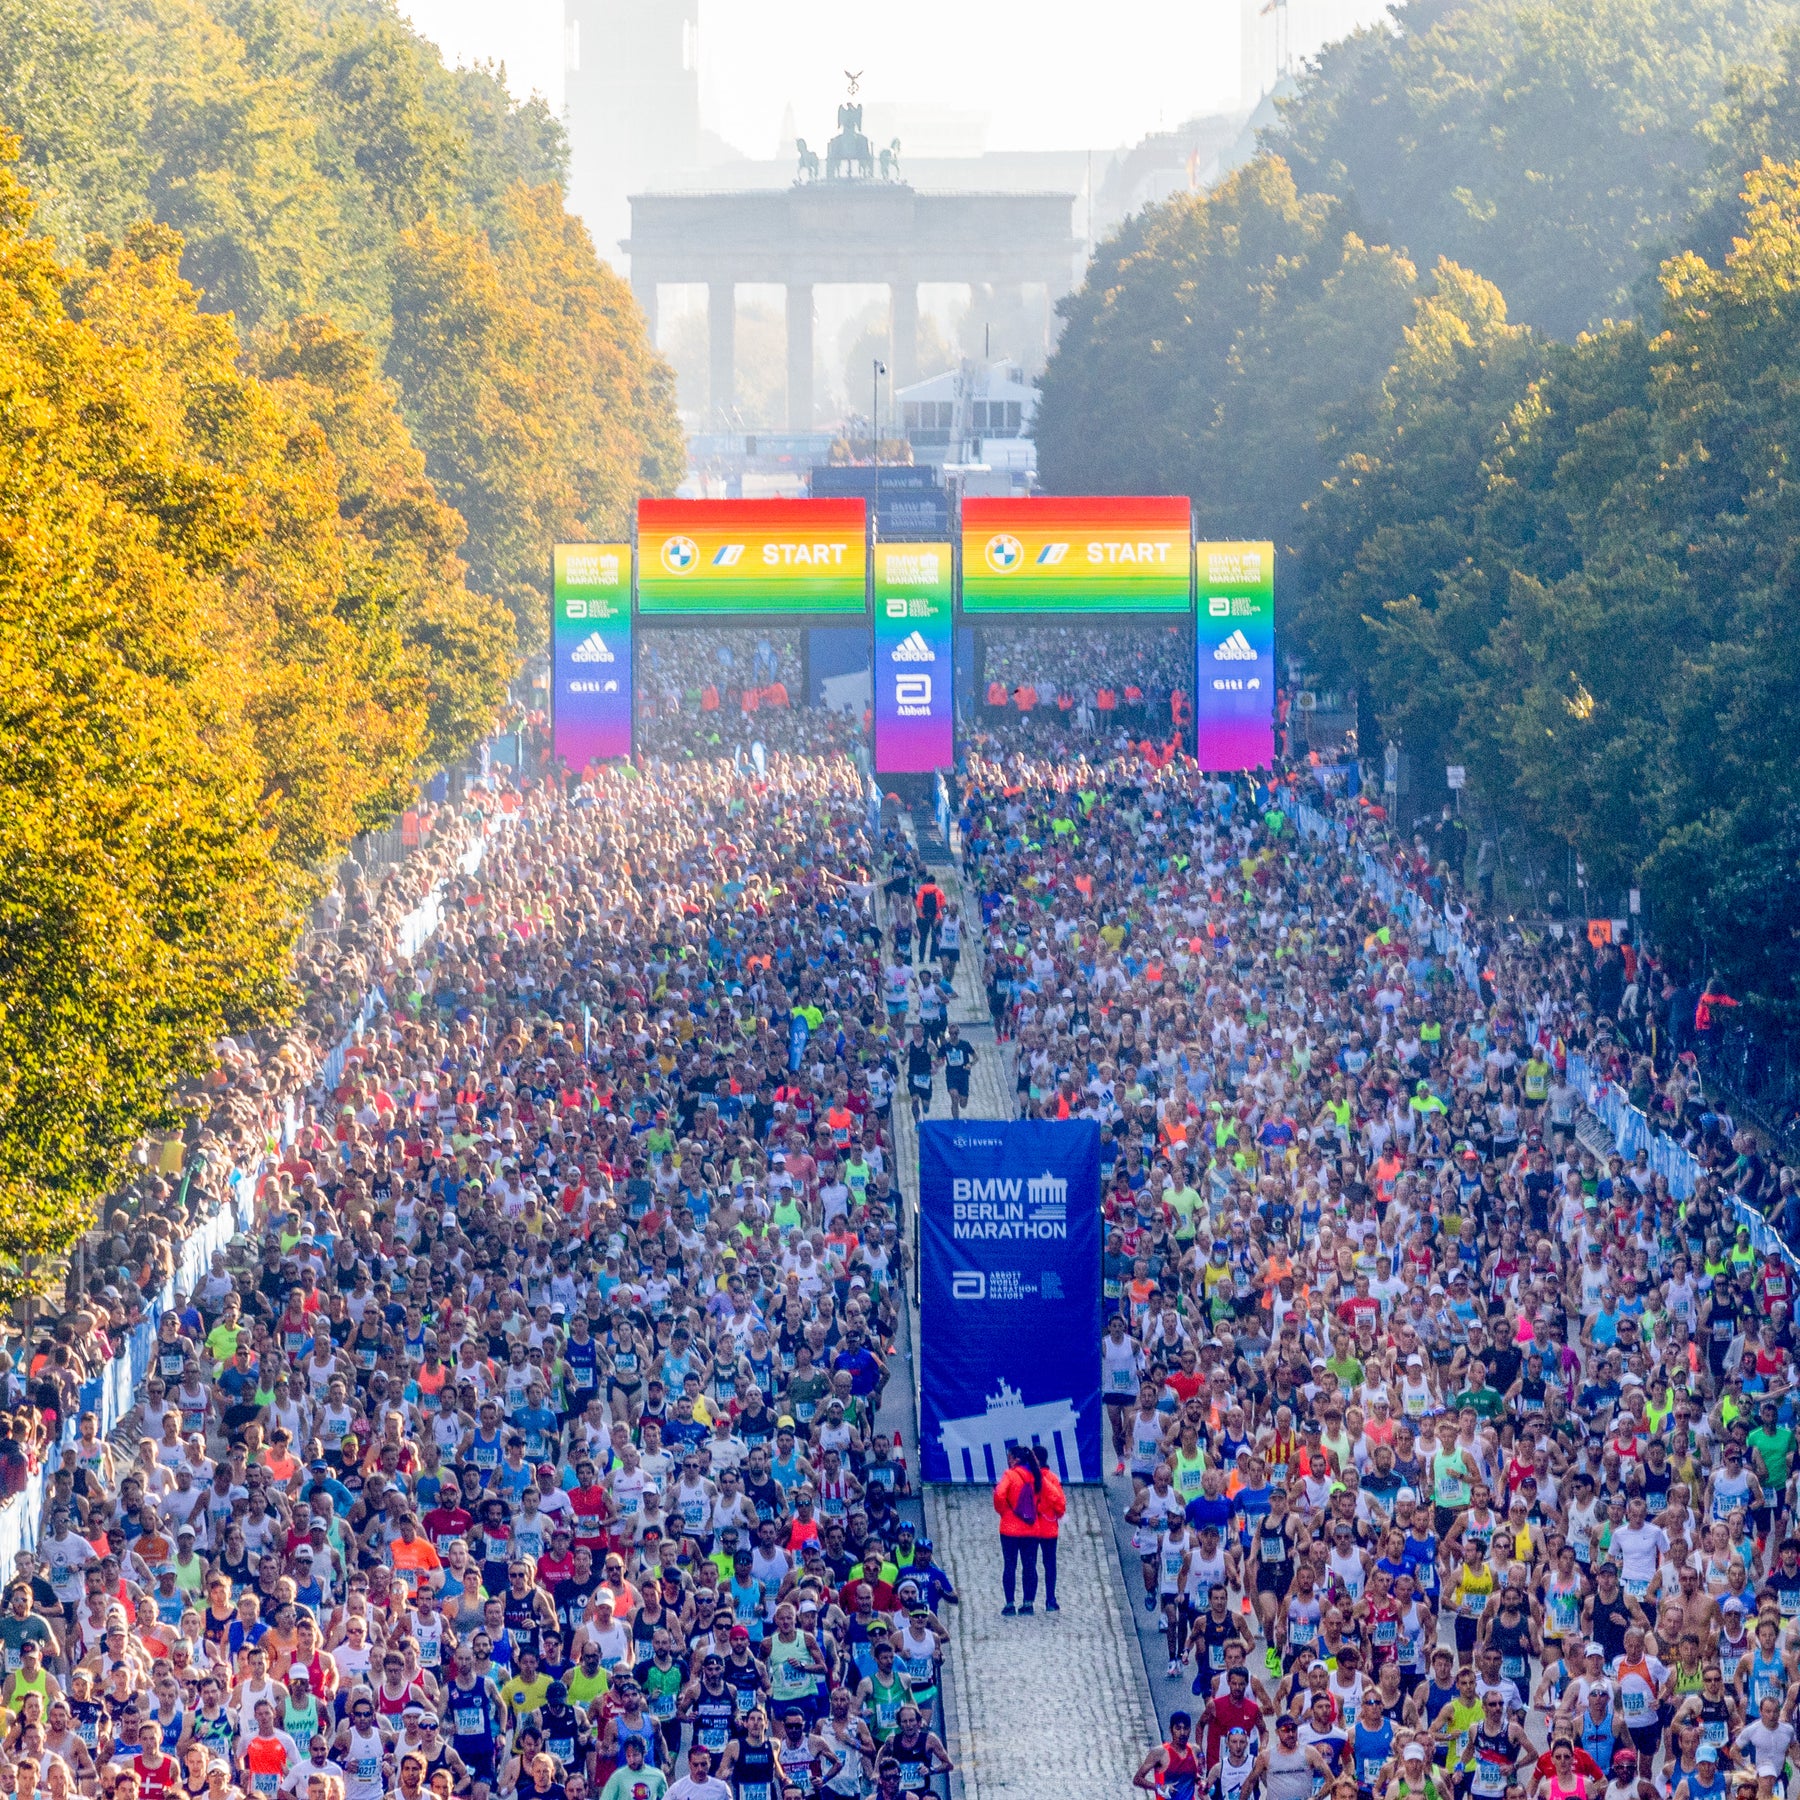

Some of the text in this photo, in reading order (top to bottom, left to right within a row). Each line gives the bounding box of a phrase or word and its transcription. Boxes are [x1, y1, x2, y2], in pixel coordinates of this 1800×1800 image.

[762, 544, 847, 566] START
[1087, 542, 1171, 564] START
[566, 556, 598, 568] BMW
[886, 555, 918, 568] BMW
[1208, 554, 1240, 566] BMW
[886, 568, 918, 576] BERLIN
[1208, 566, 1240, 574] BERLIN
[566, 577, 618, 585] MARATHON
[886, 576, 938, 584] MARATHON
[1208, 575, 1260, 583] MARATHON
[572, 651, 614, 662] adidas
[892, 650, 935, 662] adidas
[1214, 648, 1258, 661] adidas
[897, 704, 931, 716] Abbott
[953, 1178, 1022, 1202] BMW
[954, 1203, 1024, 1220] BERLIN
[954, 1222, 1067, 1239] MARATHON
[990, 1292, 1024, 1300] MAJORS
